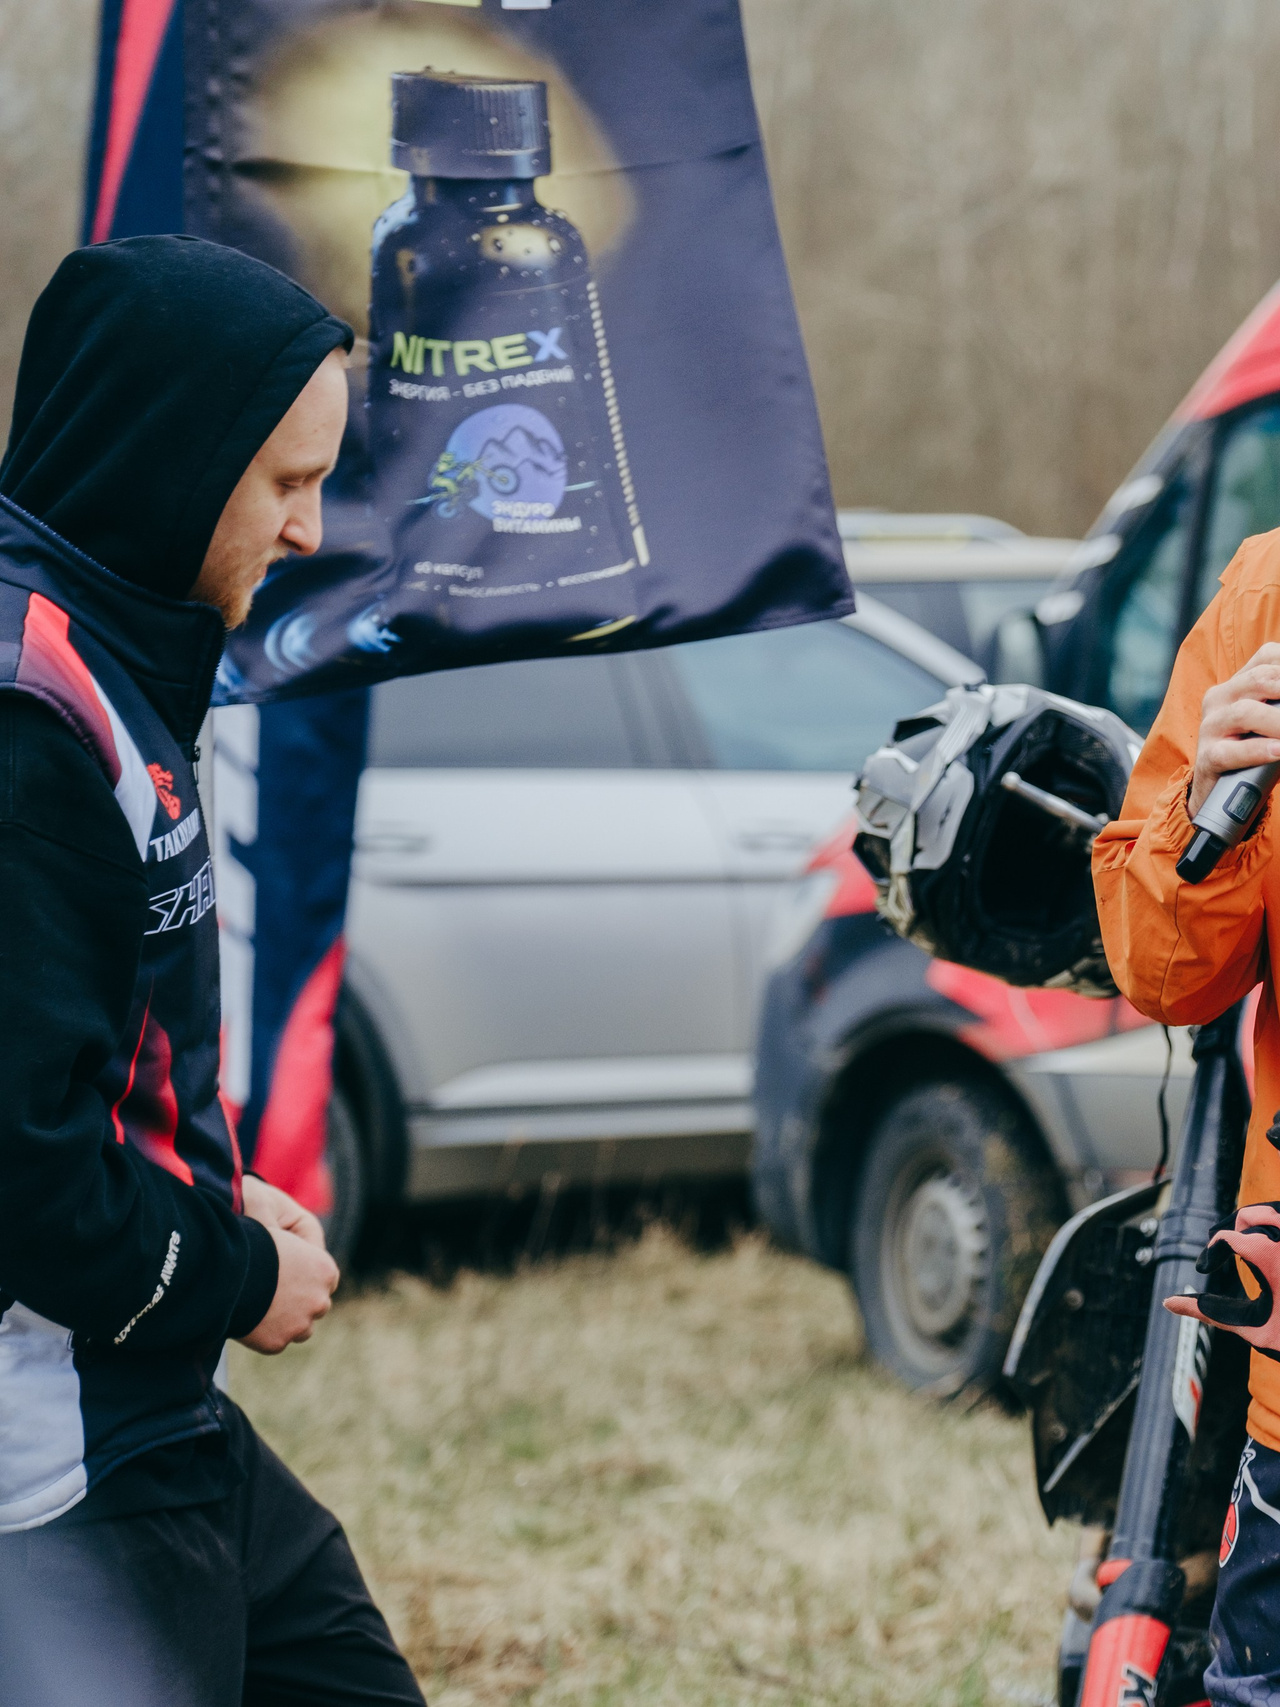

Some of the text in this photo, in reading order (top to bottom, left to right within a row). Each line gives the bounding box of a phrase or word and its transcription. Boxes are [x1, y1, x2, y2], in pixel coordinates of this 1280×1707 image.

[391, 327, 568, 376] NITREX
[463, 378, 500, 399] БЕЗ
[500, 365, 575, 390] ПАДЕНИЙ
[491, 500, 556, 518] ЭНДУРО
[493, 516, 582, 534] ВИТАМИНЫ
